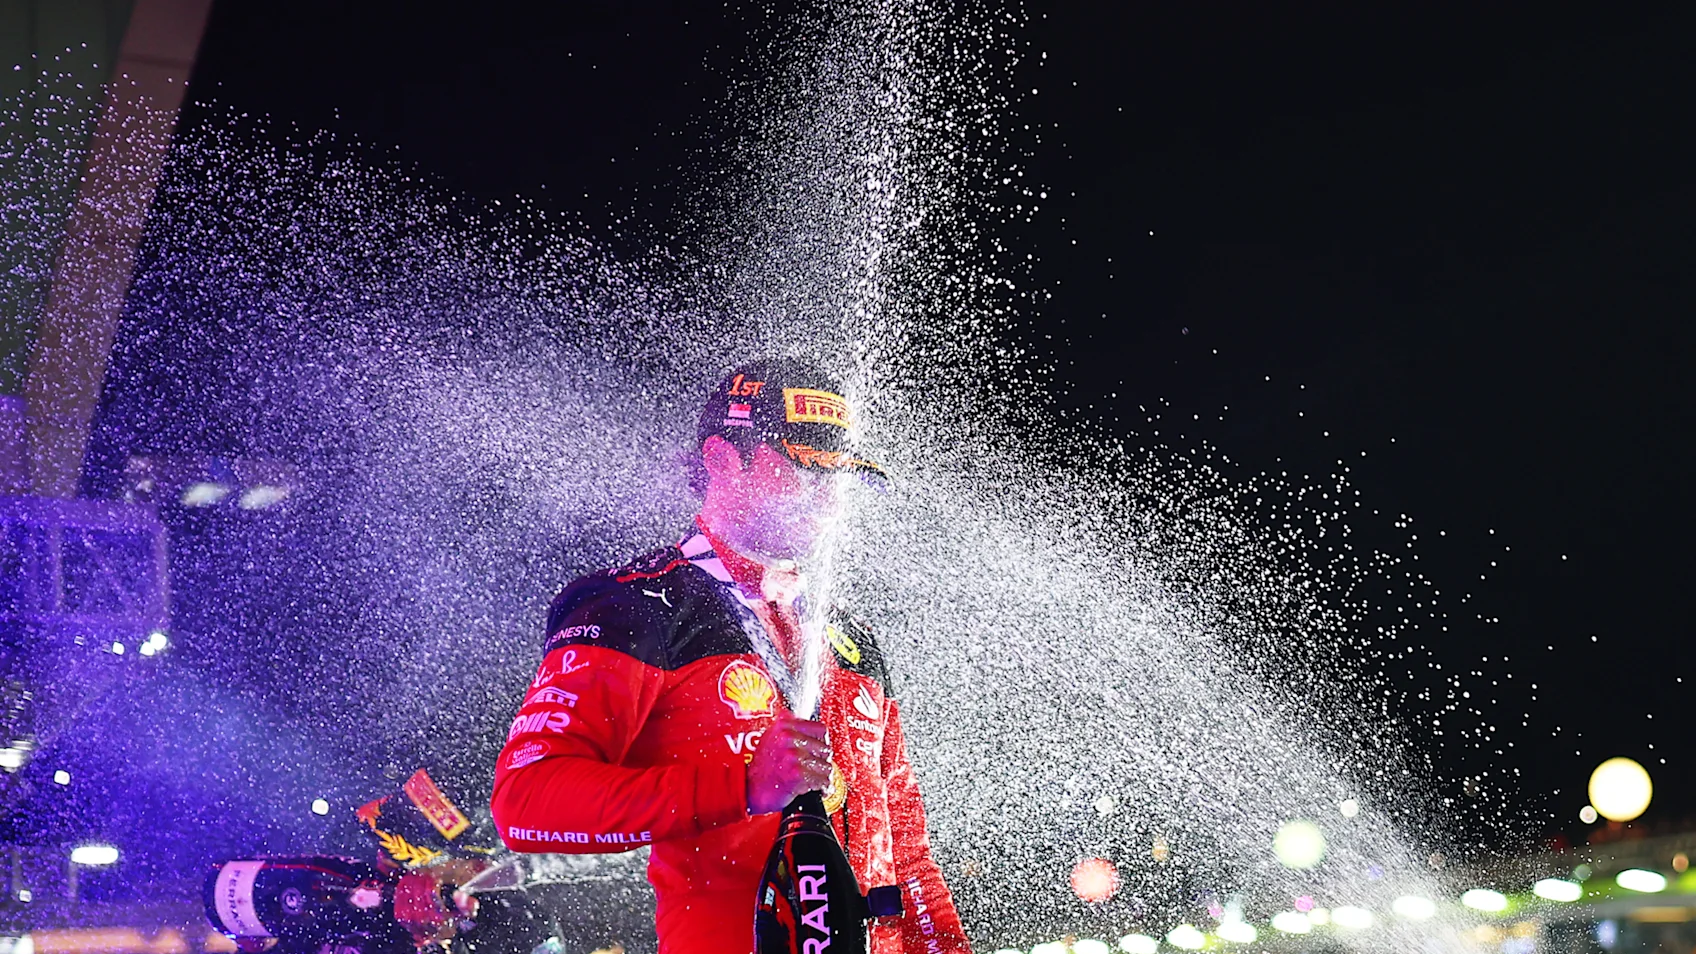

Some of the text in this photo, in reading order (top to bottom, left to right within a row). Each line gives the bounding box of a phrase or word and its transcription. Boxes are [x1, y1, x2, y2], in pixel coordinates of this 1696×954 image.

[728, 373, 765, 396] 1ST
[508, 826, 653, 845] RICHARD MILLE
